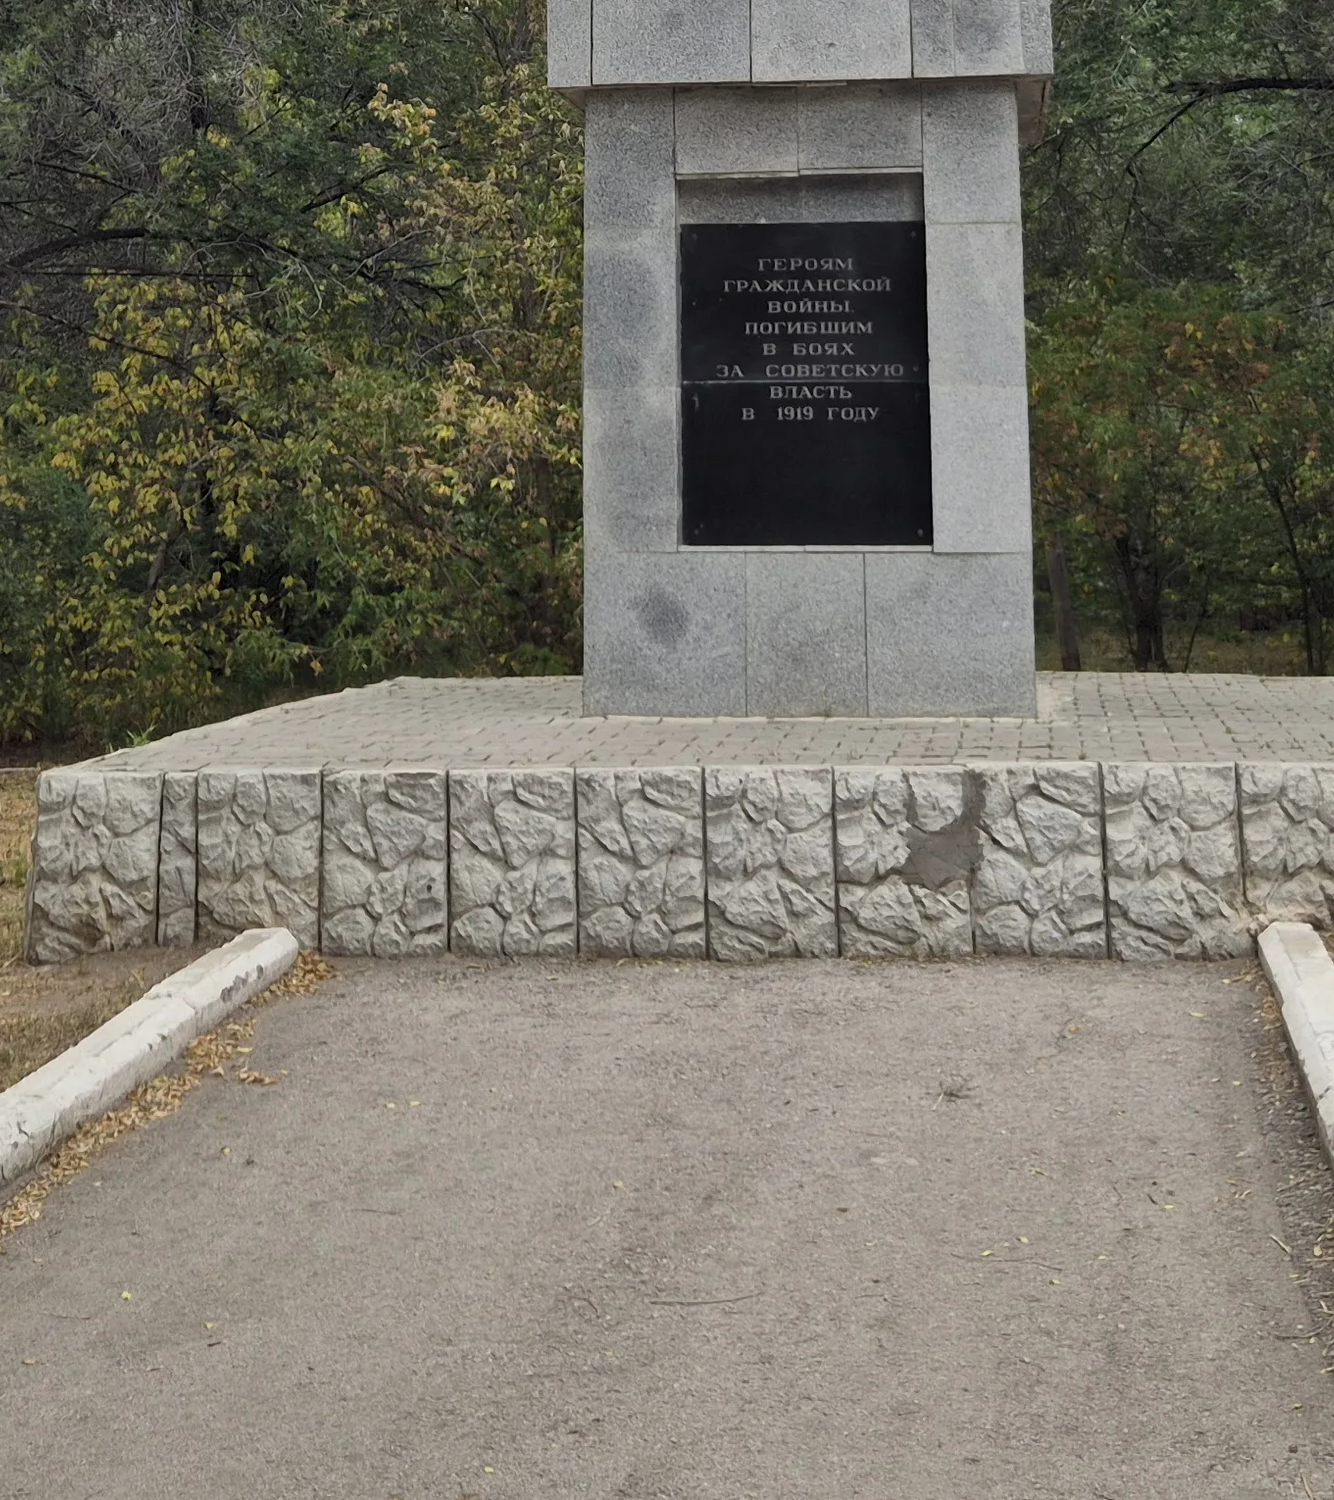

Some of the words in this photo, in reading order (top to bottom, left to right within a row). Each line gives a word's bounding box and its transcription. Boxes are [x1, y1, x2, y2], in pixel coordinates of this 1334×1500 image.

[758, 258, 854, 271] ГЕРОЯМ
[723, 277, 891, 295] ГРАЖДАНСКОЙ
[745, 321, 873, 334] ПОГИБШИМ
[763, 343, 776, 356] В
[793, 343, 855, 356] БОЯХ
[716, 364, 745, 378] ЗА
[765, 364, 904, 377] СОВЕТСКУЮ
[769, 386, 853, 399] ВЛАСТЬ
[742, 408, 755, 421] В
[777, 407, 814, 421] 1919
[827, 407, 880, 423] ГОДУ
